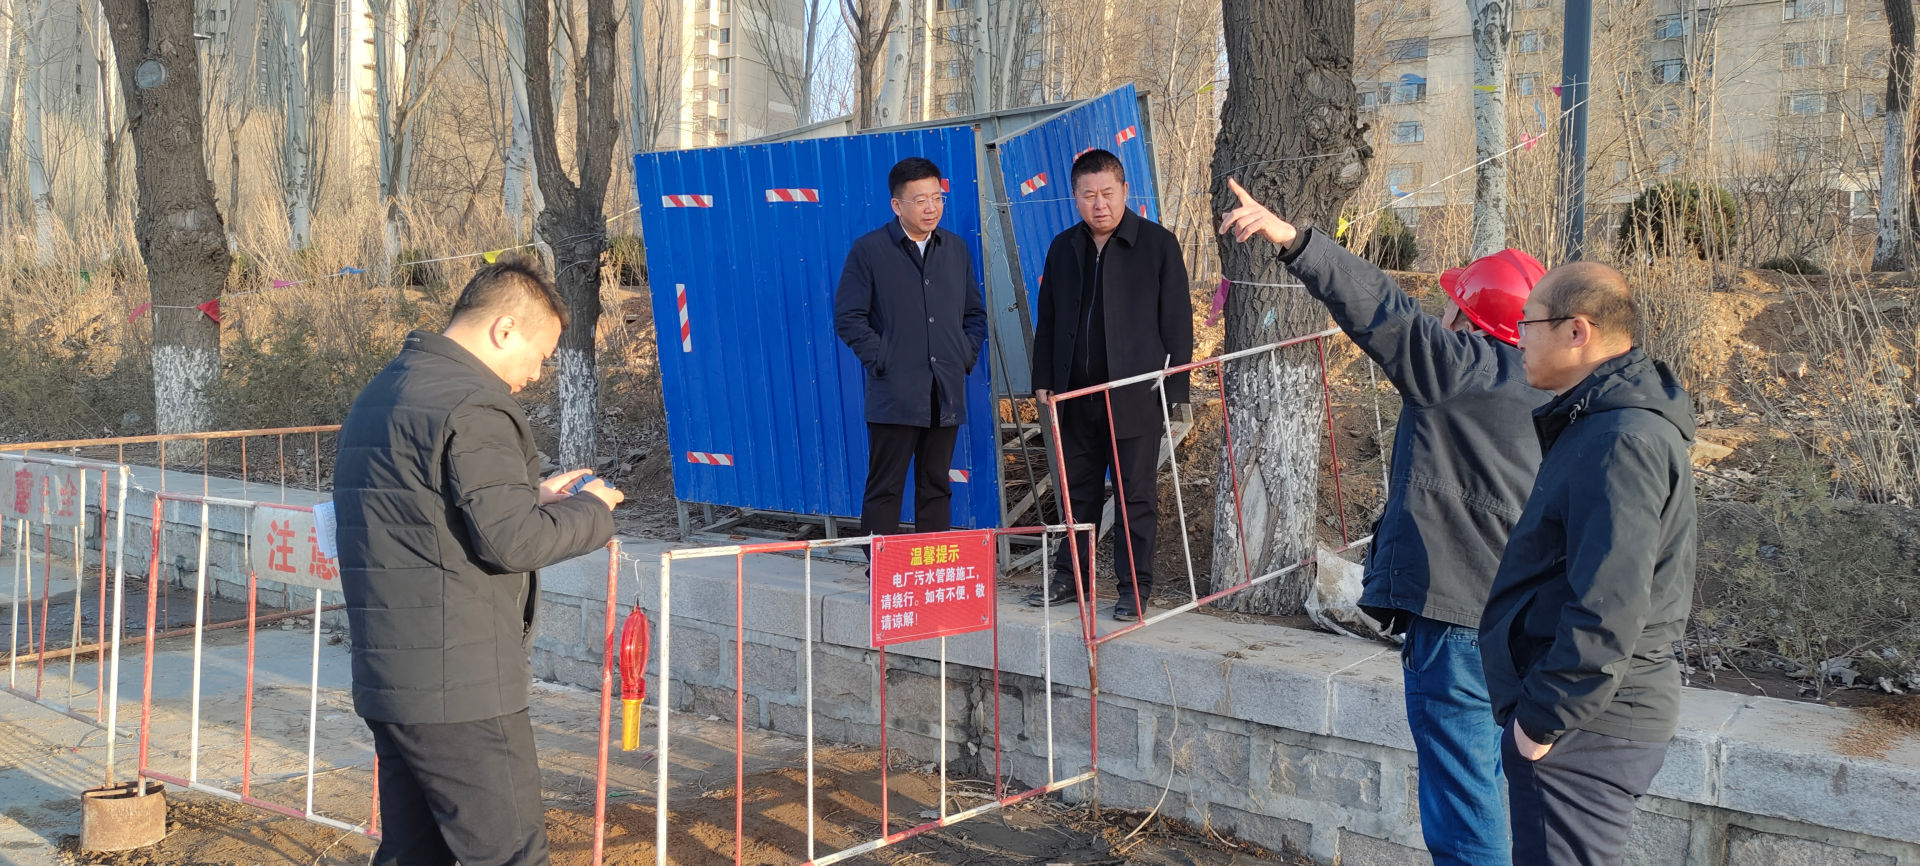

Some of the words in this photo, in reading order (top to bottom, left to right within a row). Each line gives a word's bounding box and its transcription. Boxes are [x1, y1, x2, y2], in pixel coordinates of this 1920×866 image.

[910, 544, 960, 566] 温馨提示
[892, 566, 980, 588] 电厂污水管路施工,
[880, 611, 918, 631] 请谅解!
